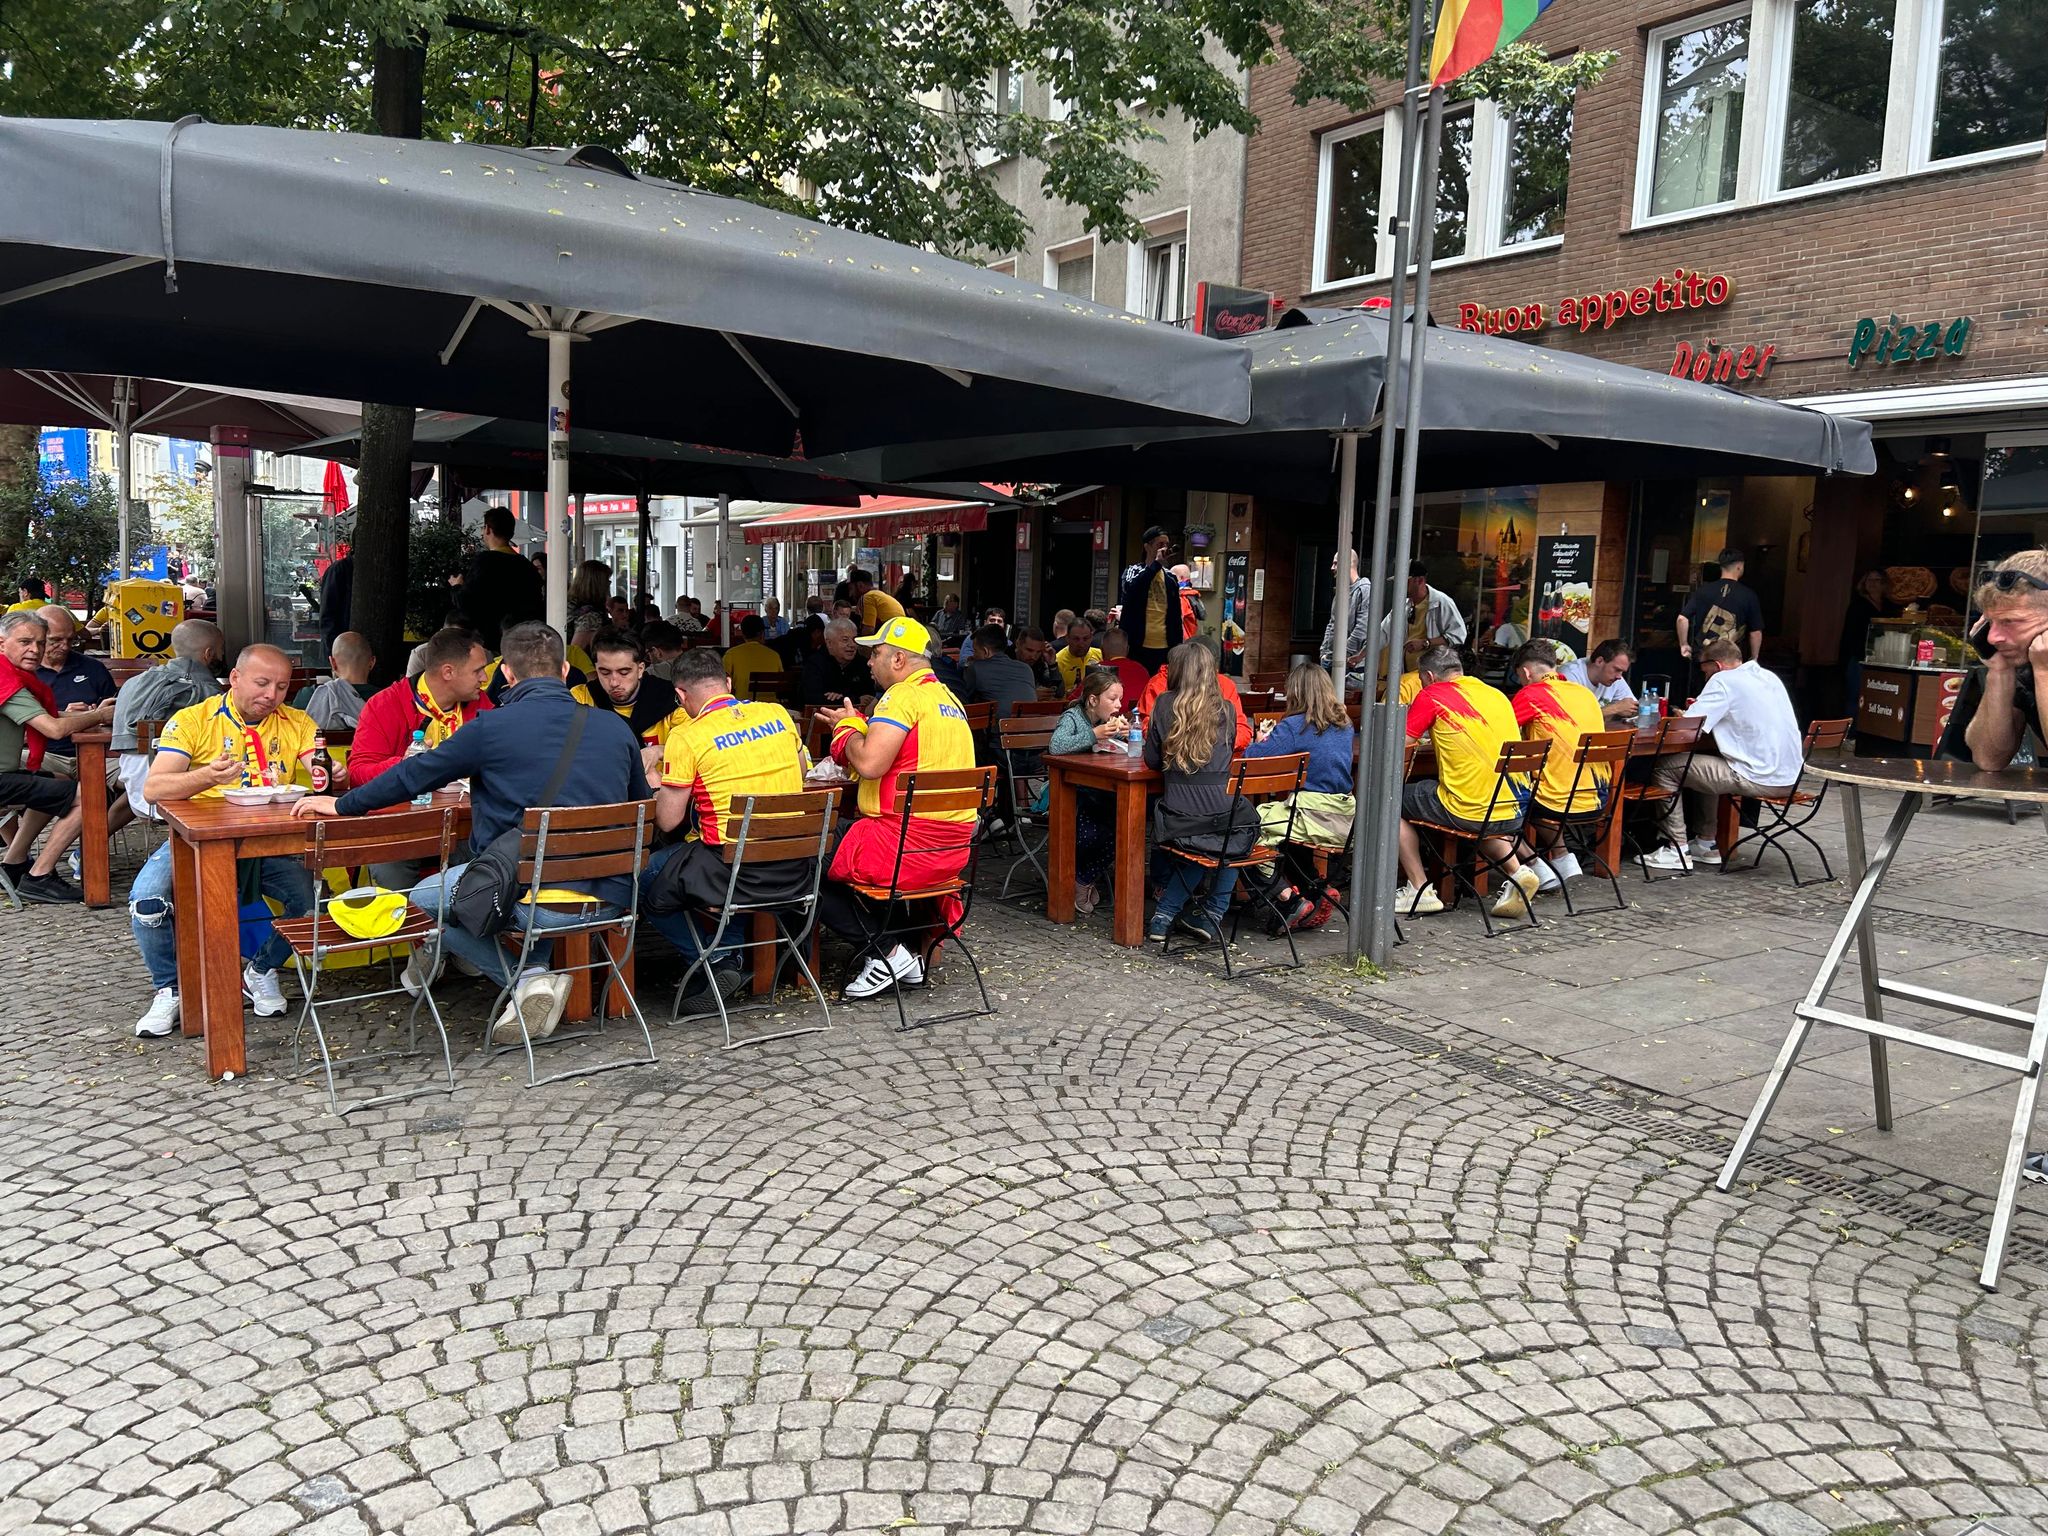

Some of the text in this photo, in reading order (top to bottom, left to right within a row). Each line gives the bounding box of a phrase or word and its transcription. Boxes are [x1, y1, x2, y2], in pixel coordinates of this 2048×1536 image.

[1456, 267, 1733, 335] Buon appetito
[1669, 336, 1778, 383] Döner
[1848, 311, 1973, 368] Pizza
[827, 521, 869, 539] LYLY
[713, 718, 786, 751] ROMANIA
